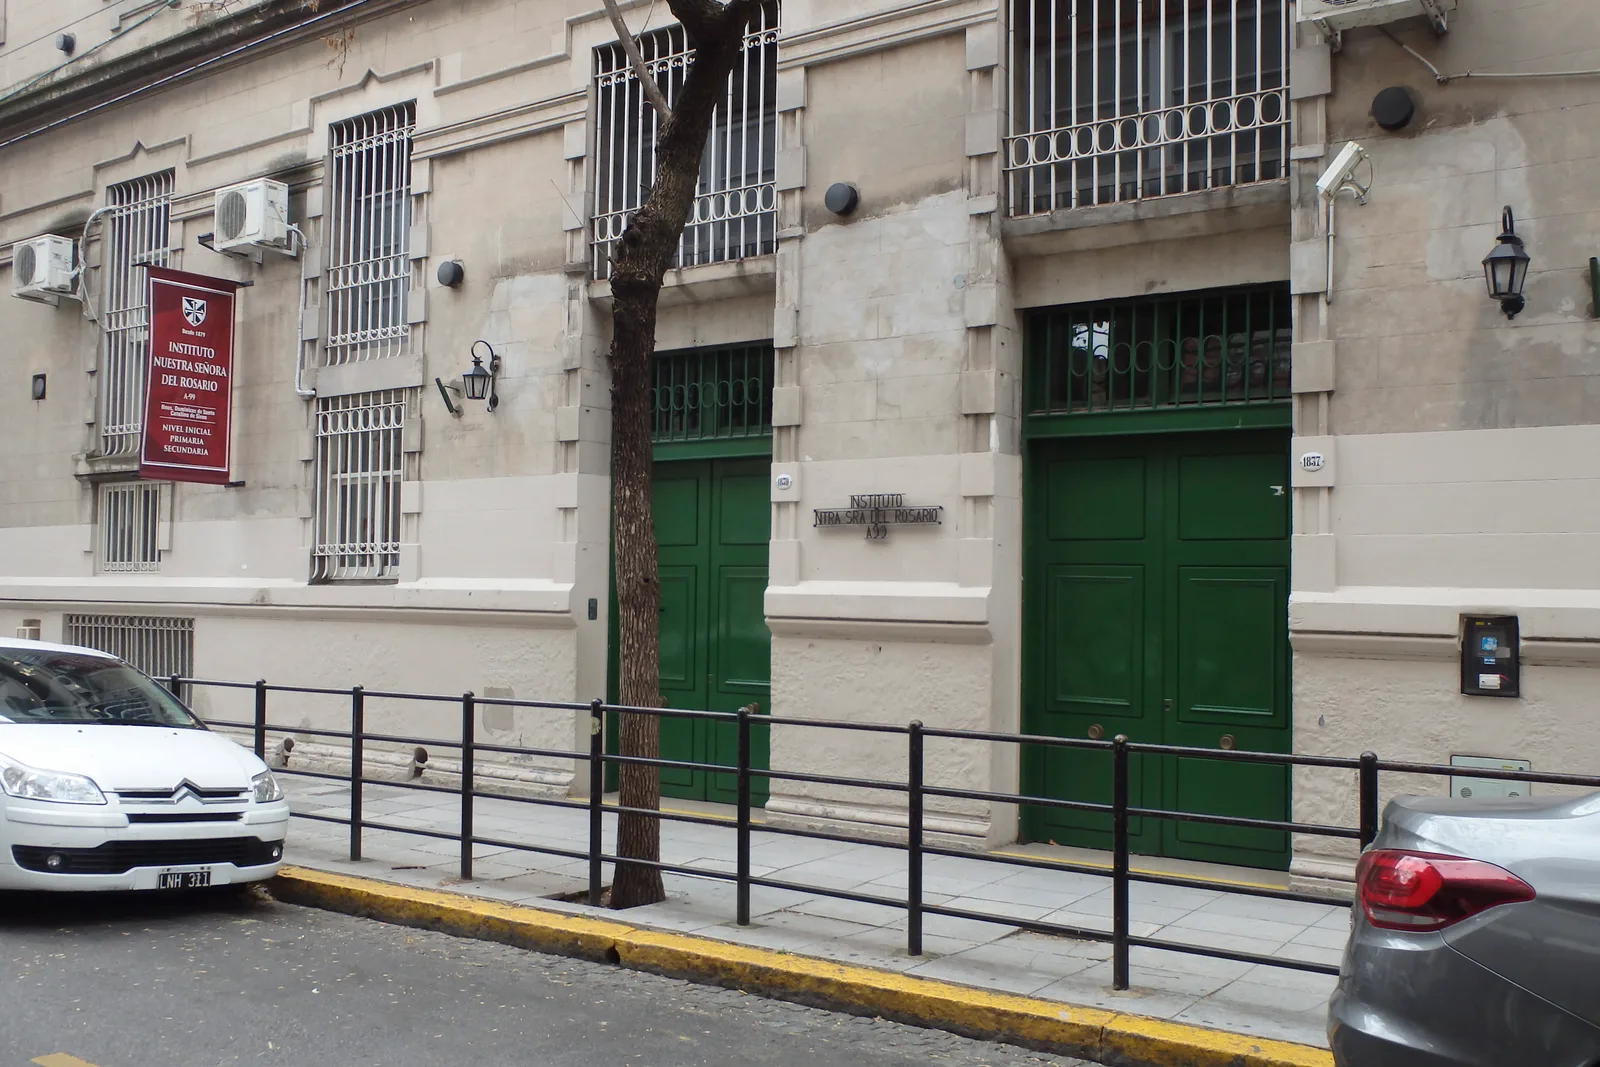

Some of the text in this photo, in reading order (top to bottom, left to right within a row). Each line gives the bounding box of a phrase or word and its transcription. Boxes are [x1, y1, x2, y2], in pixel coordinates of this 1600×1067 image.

[182, 328, 194, 336] Desde
[168, 342, 214, 358] INSTITUTO
[154, 356, 227, 376] NUESTRA SEÑORA
[162, 374, 218, 392] DEL ROSARIO
[162, 424, 212, 436] NIVEL INICIAL
[170, 436, 204, 445] PRIMARIA
[164, 445, 208, 456] SECUNDARIA
[1304, 456, 1320, 467] 1837
[850, 494, 903, 508] INSTITUTO
[815, 508, 938, 525] NTRA SRA DEL ROSARIO
[160, 872, 209, 889] LNH 311
